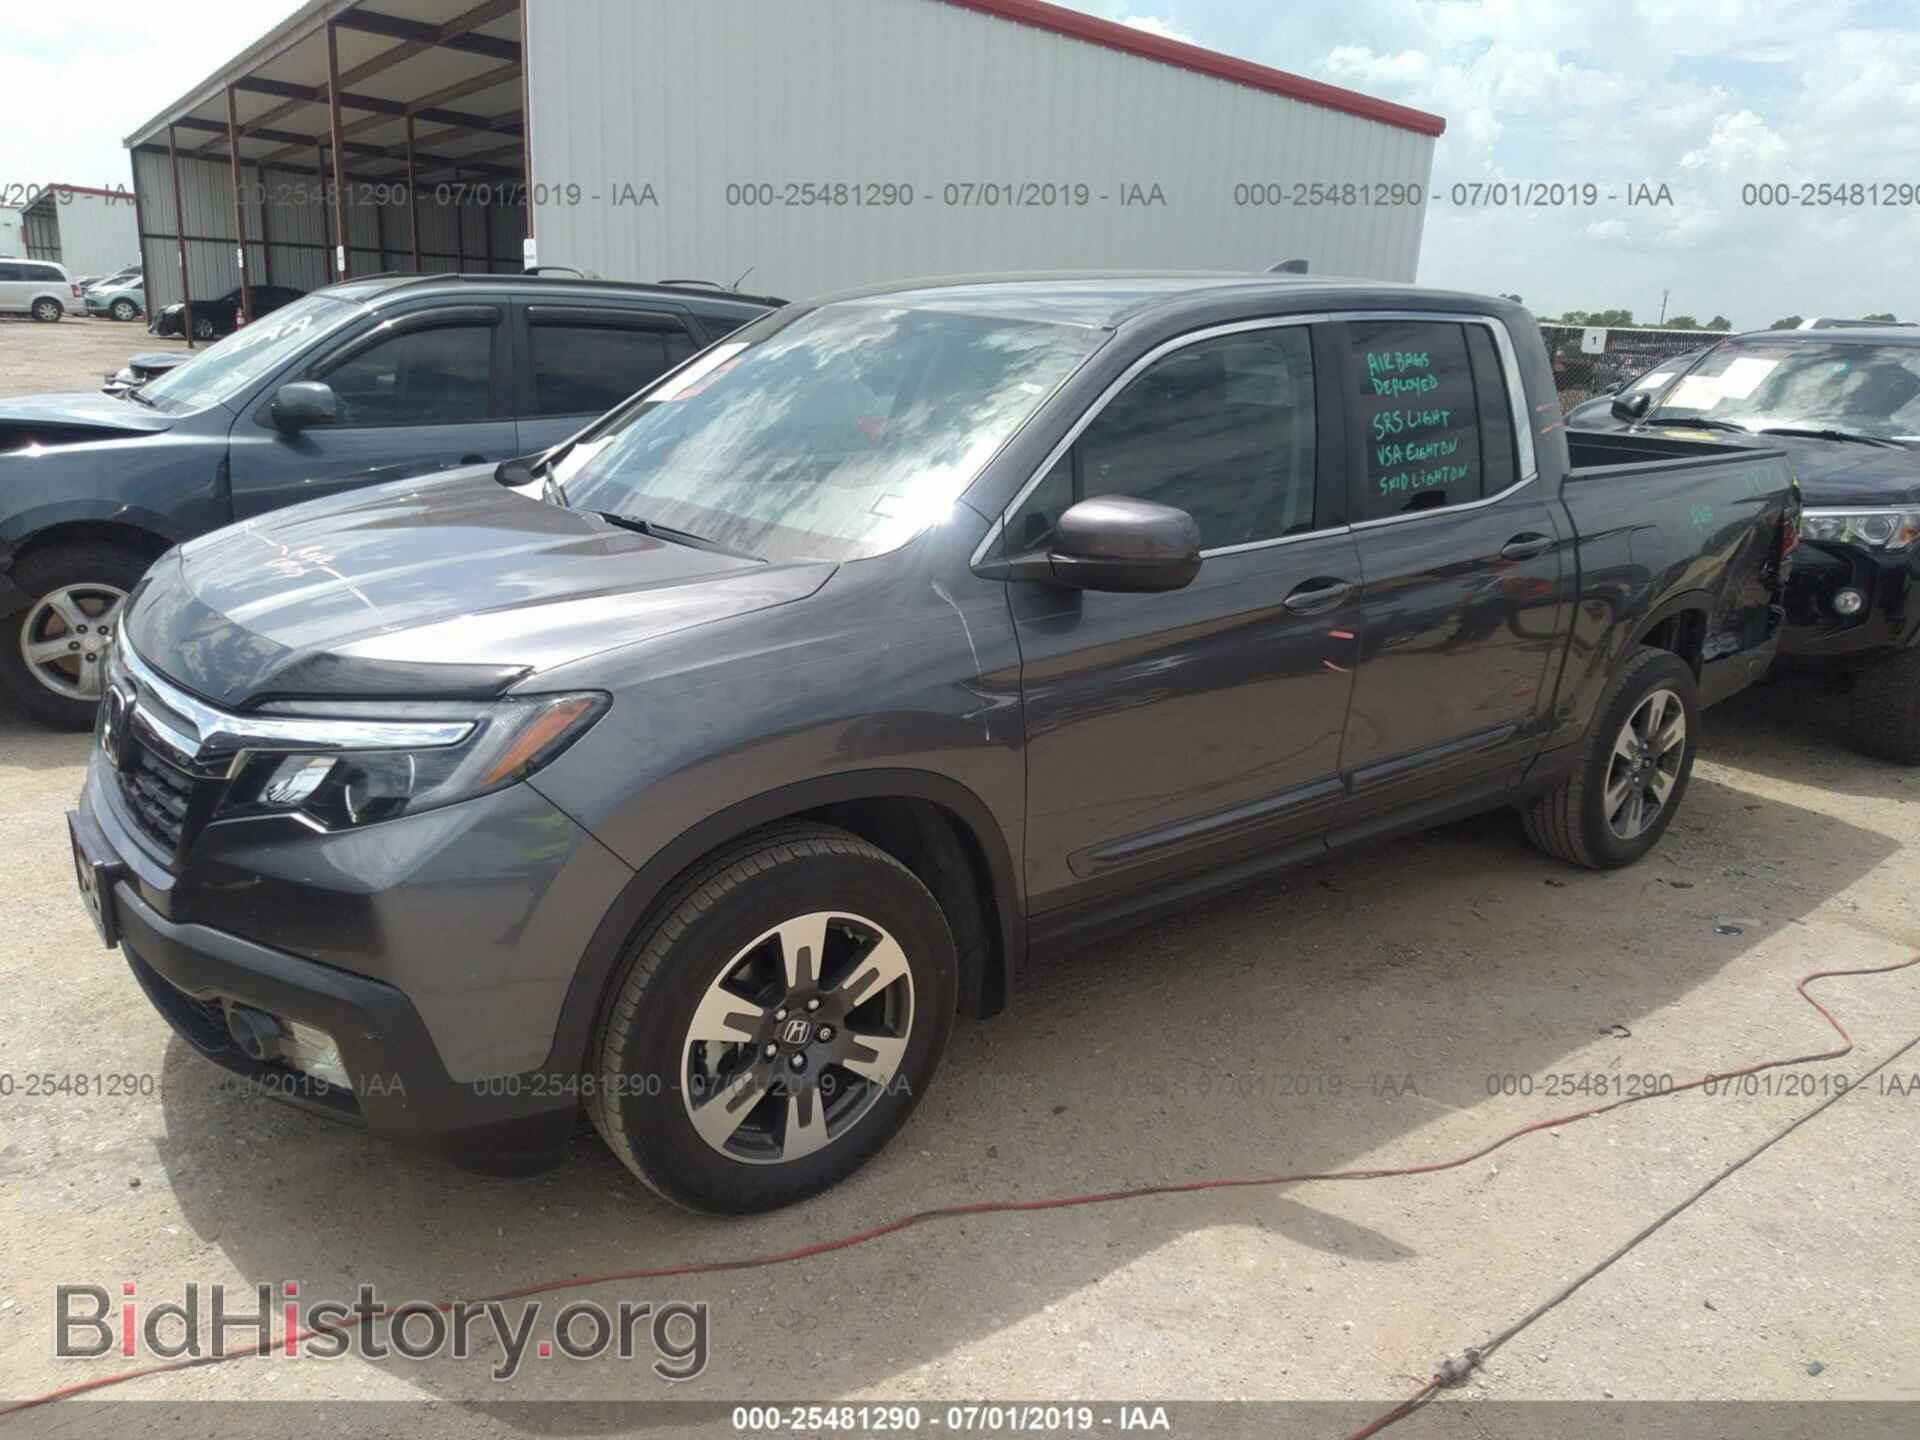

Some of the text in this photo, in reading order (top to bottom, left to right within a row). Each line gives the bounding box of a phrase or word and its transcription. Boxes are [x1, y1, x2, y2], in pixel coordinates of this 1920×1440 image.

[1372, 374, 1438, 397] DEPLOYED
[1373, 410, 1450, 440] SRS LIGHT
[1377, 445, 1403, 467] VSA
